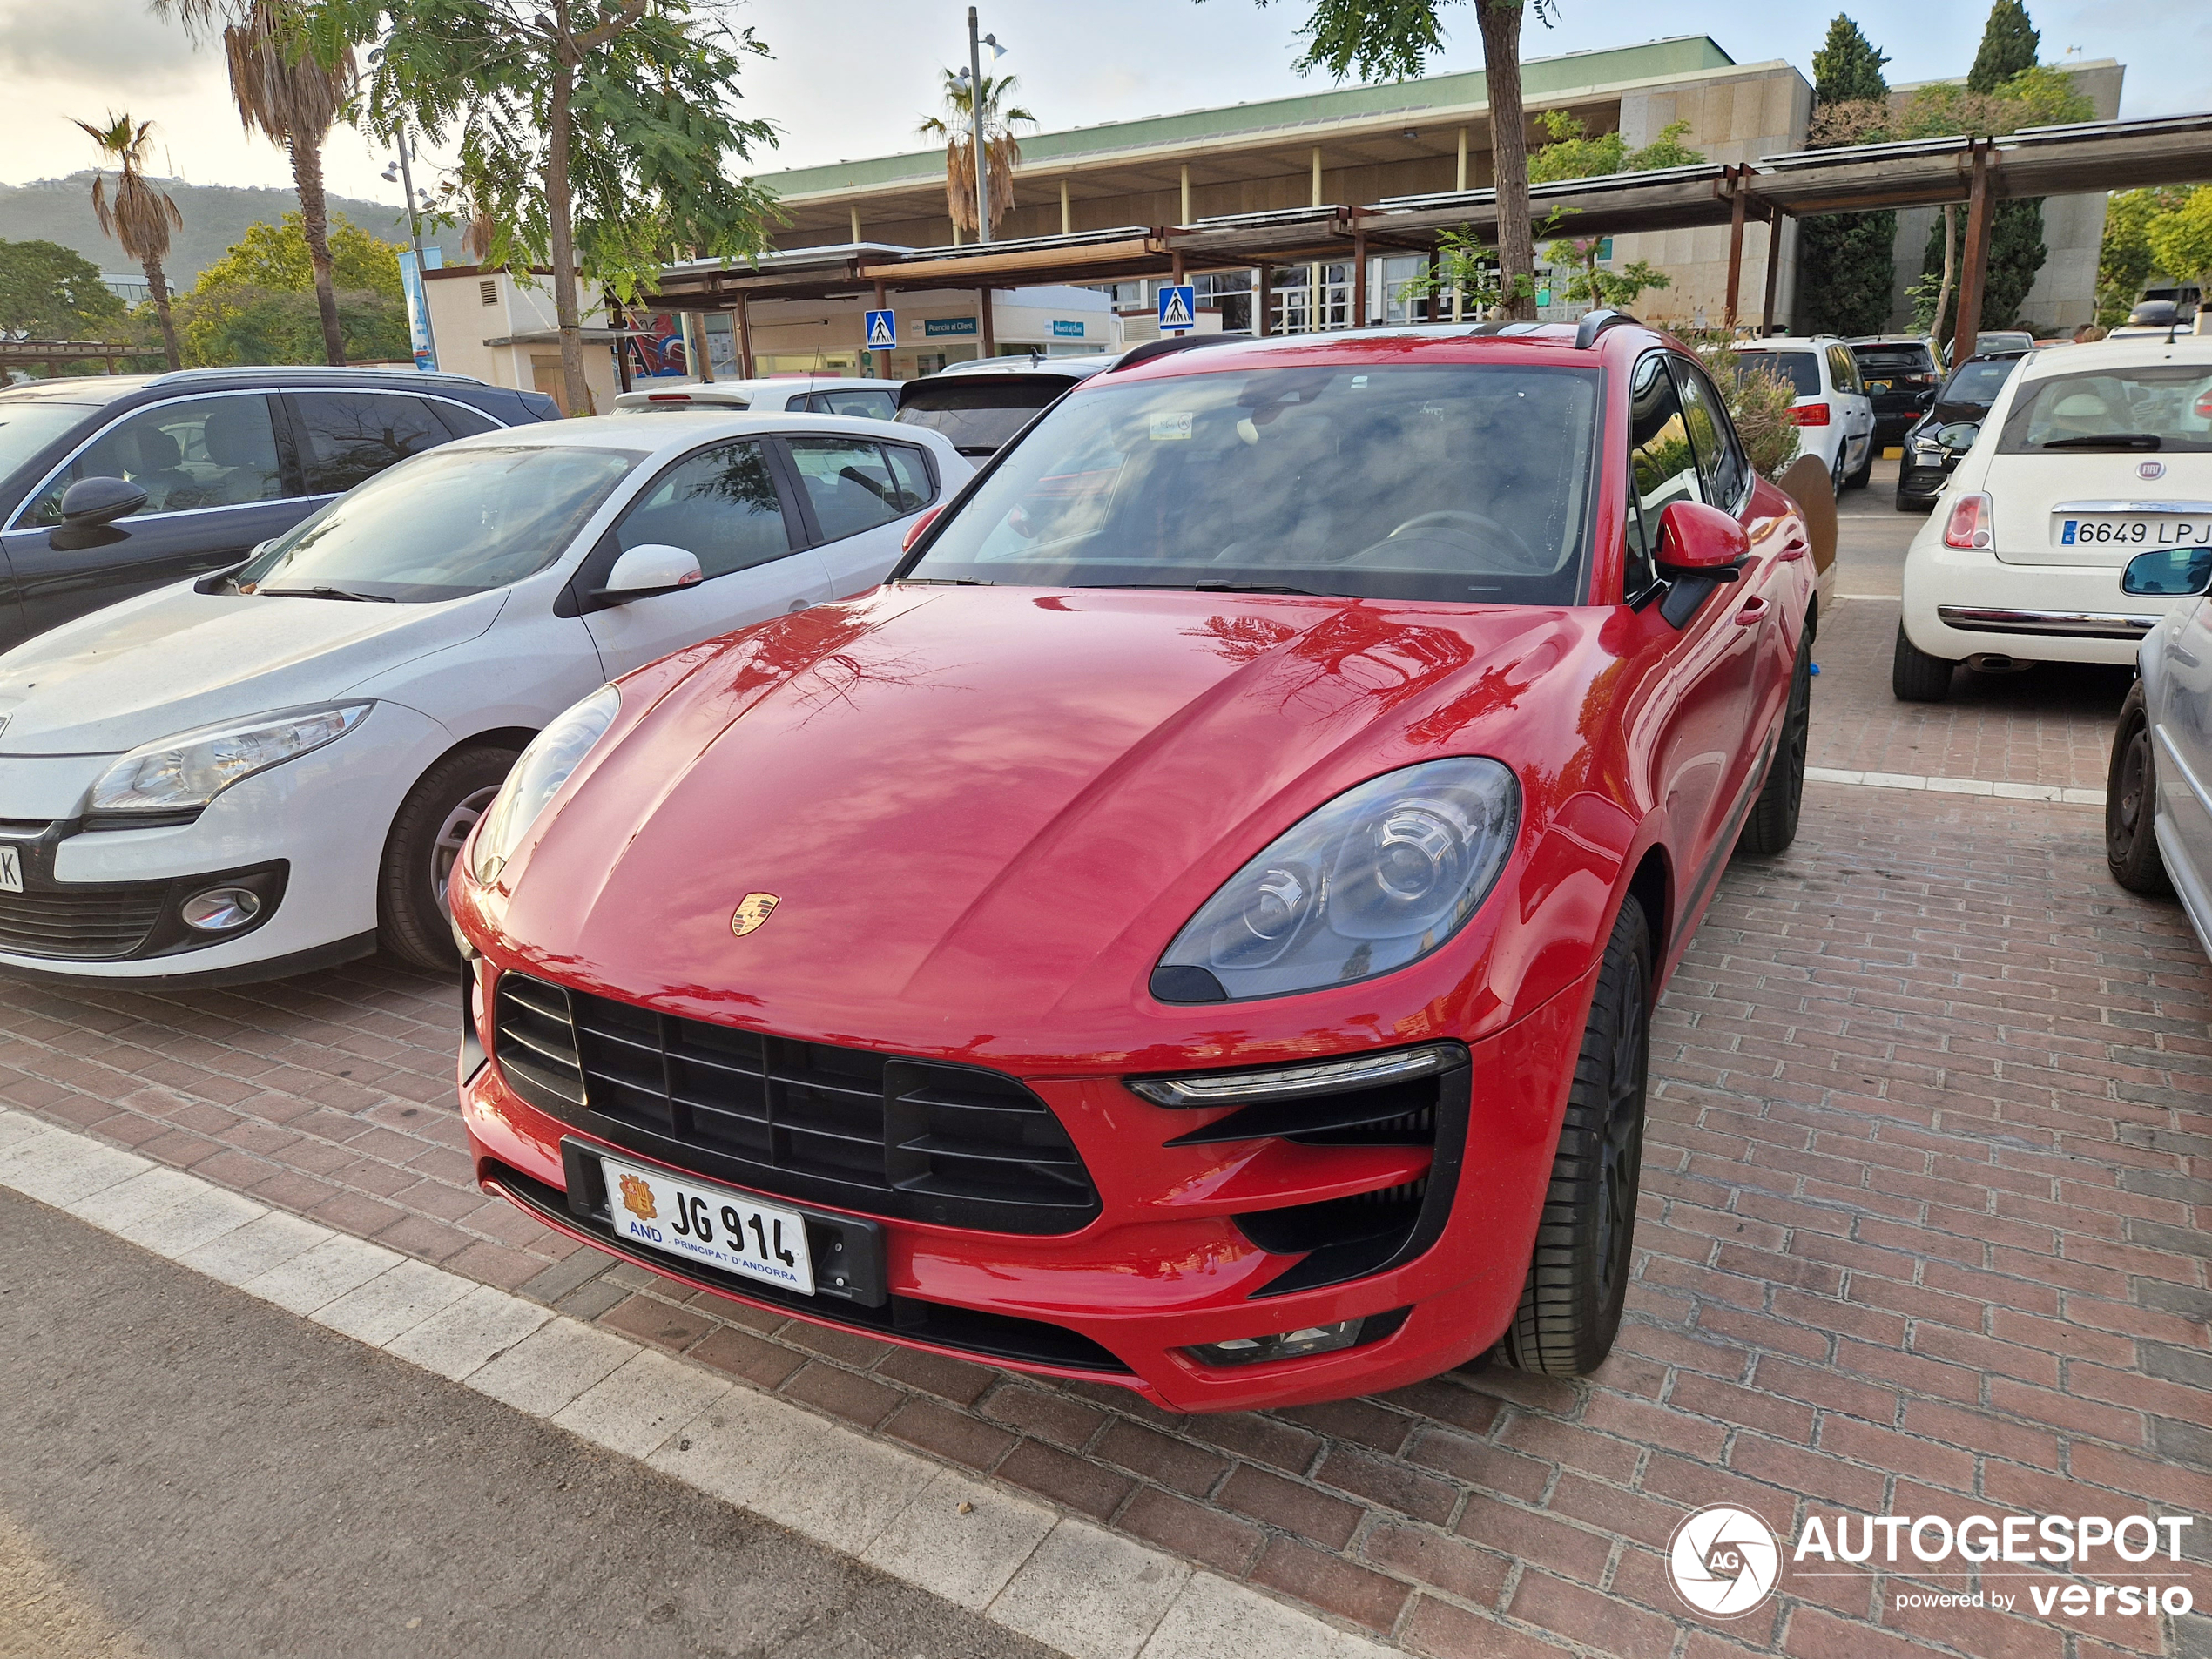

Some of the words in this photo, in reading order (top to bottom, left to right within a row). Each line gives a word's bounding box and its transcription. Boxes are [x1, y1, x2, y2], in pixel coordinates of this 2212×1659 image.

[956, 321, 974, 330] Client
[2141, 464, 2160, 475] FIAT
[2079, 523, 2148, 543] 6649
[2157, 523, 2212, 544] LPJ
[629, 1220, 663, 1244] AND
[671, 1191, 714, 1244] JG
[721, 1205, 795, 1268] 914
[673, 1238, 729, 1262] PRINCIPAT
[731, 1255, 798, 1284] D'ANDORRA
